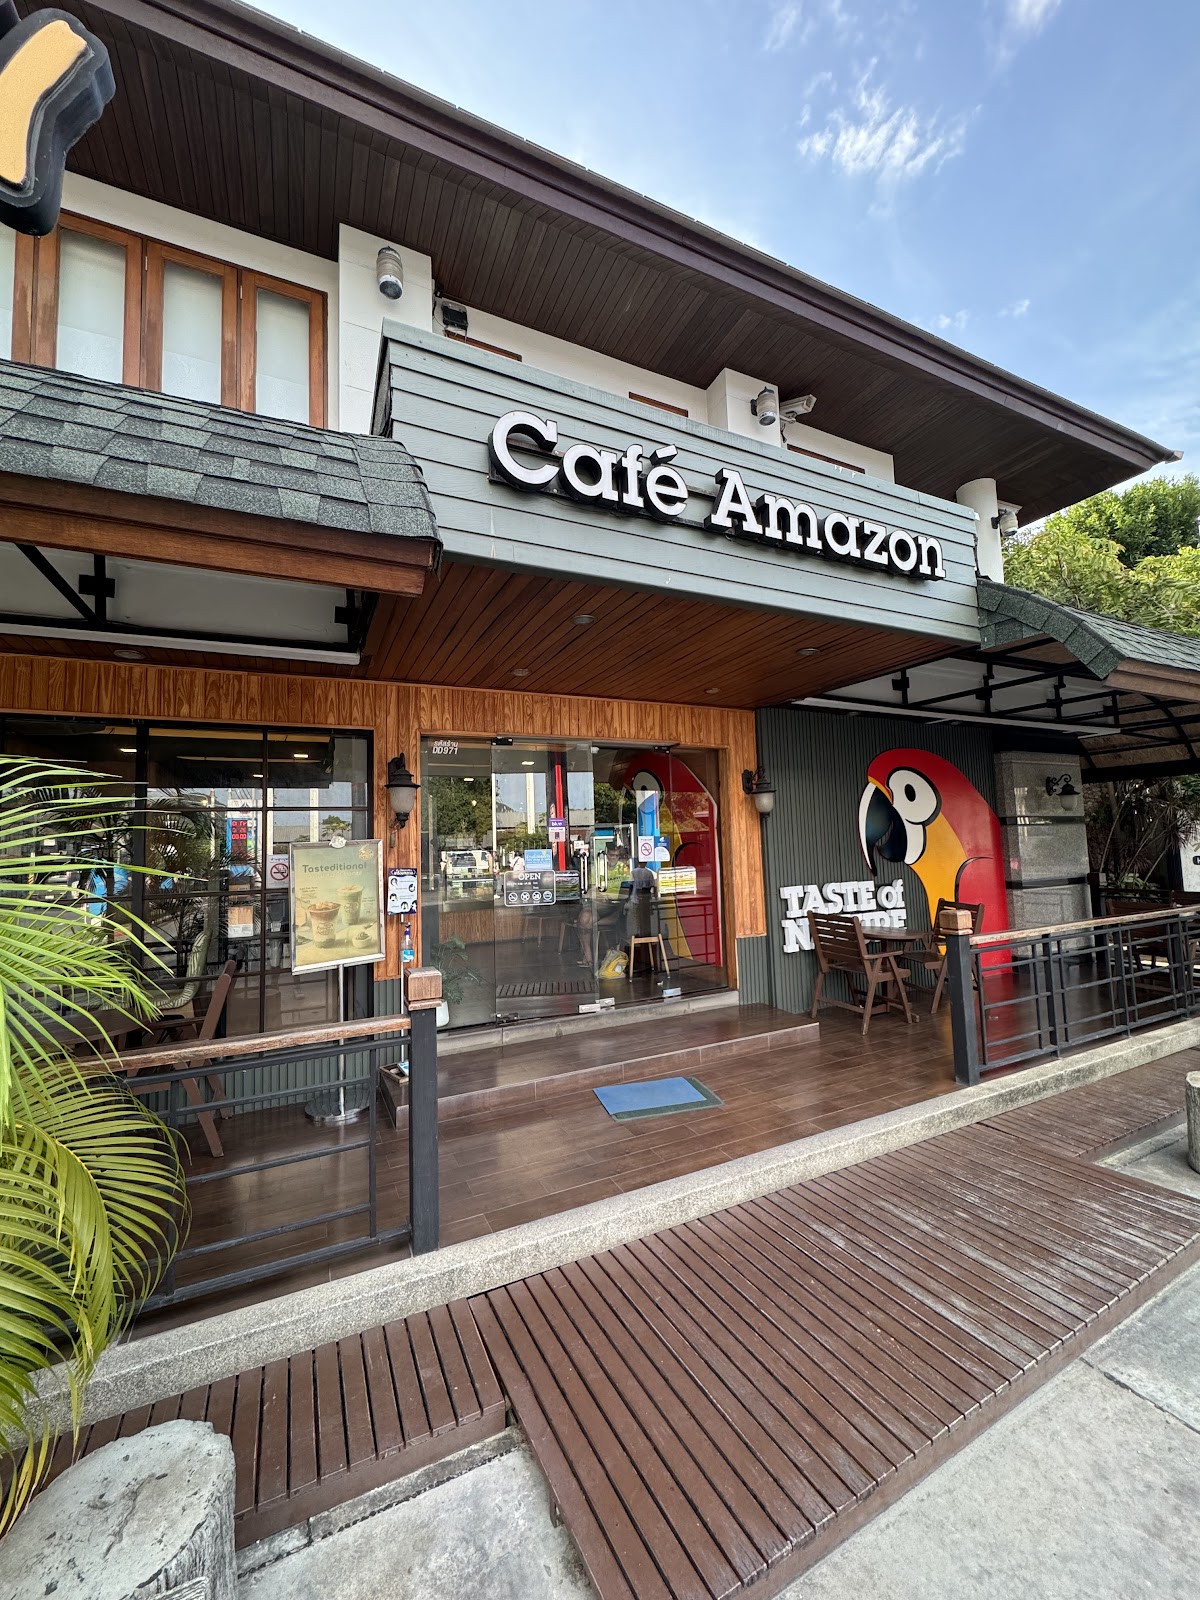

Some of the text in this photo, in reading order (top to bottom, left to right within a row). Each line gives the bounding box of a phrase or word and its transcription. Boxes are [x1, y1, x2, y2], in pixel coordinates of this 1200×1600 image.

[488, 410, 947, 581] Café Amazon
[432, 746, 459, 755] DD971
[302, 862, 367, 874] Tasteditional
[518, 872, 542, 881] OPEN
[780, 879, 905, 919] TASTE of
